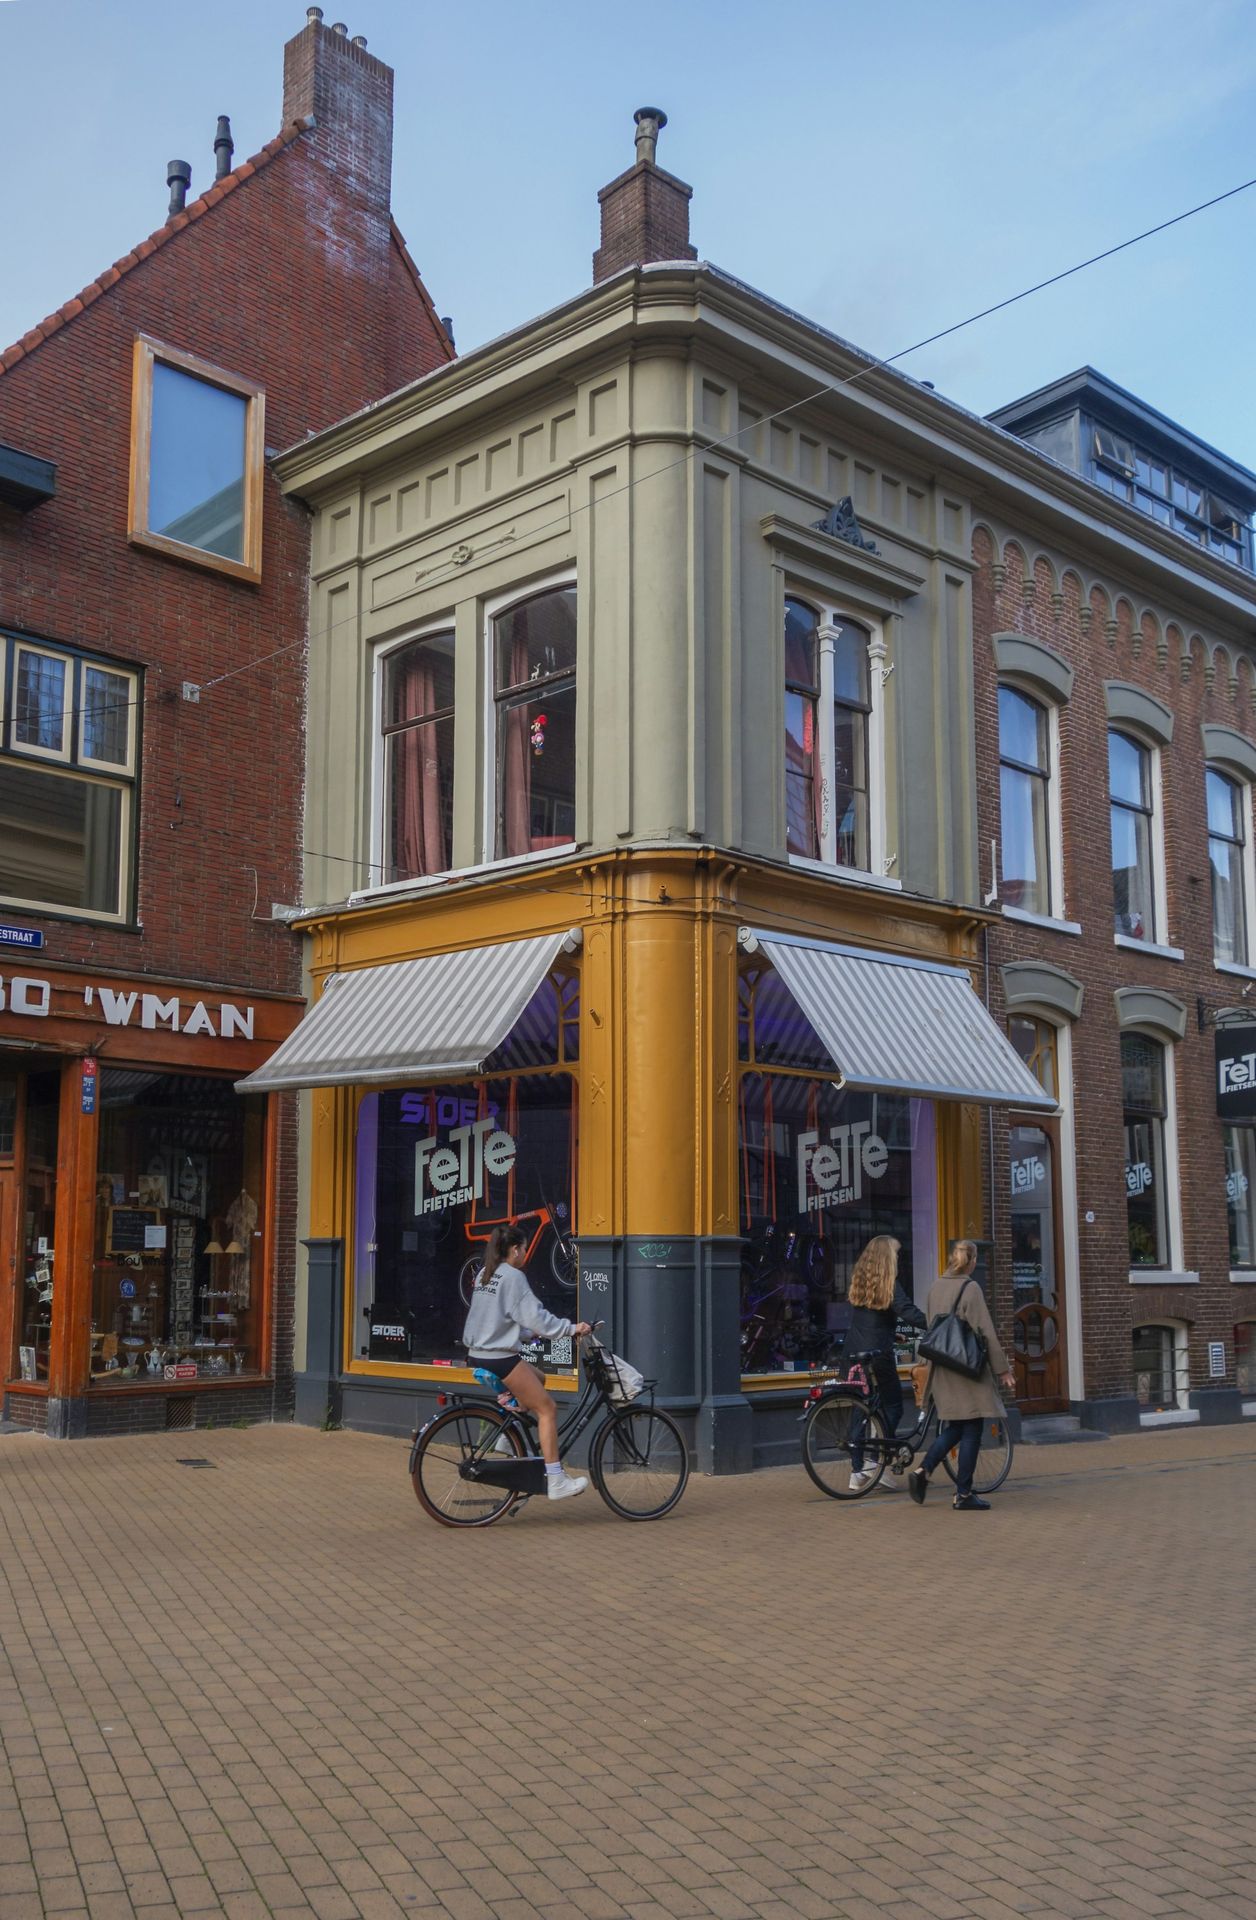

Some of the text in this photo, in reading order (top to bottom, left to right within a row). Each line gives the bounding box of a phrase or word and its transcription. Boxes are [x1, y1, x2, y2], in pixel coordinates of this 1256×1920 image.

[424, 1186, 474, 1213] FIETSEN
[808, 1187, 853, 1212] FIETSEN
[372, 1325, 405, 1336] STOER
